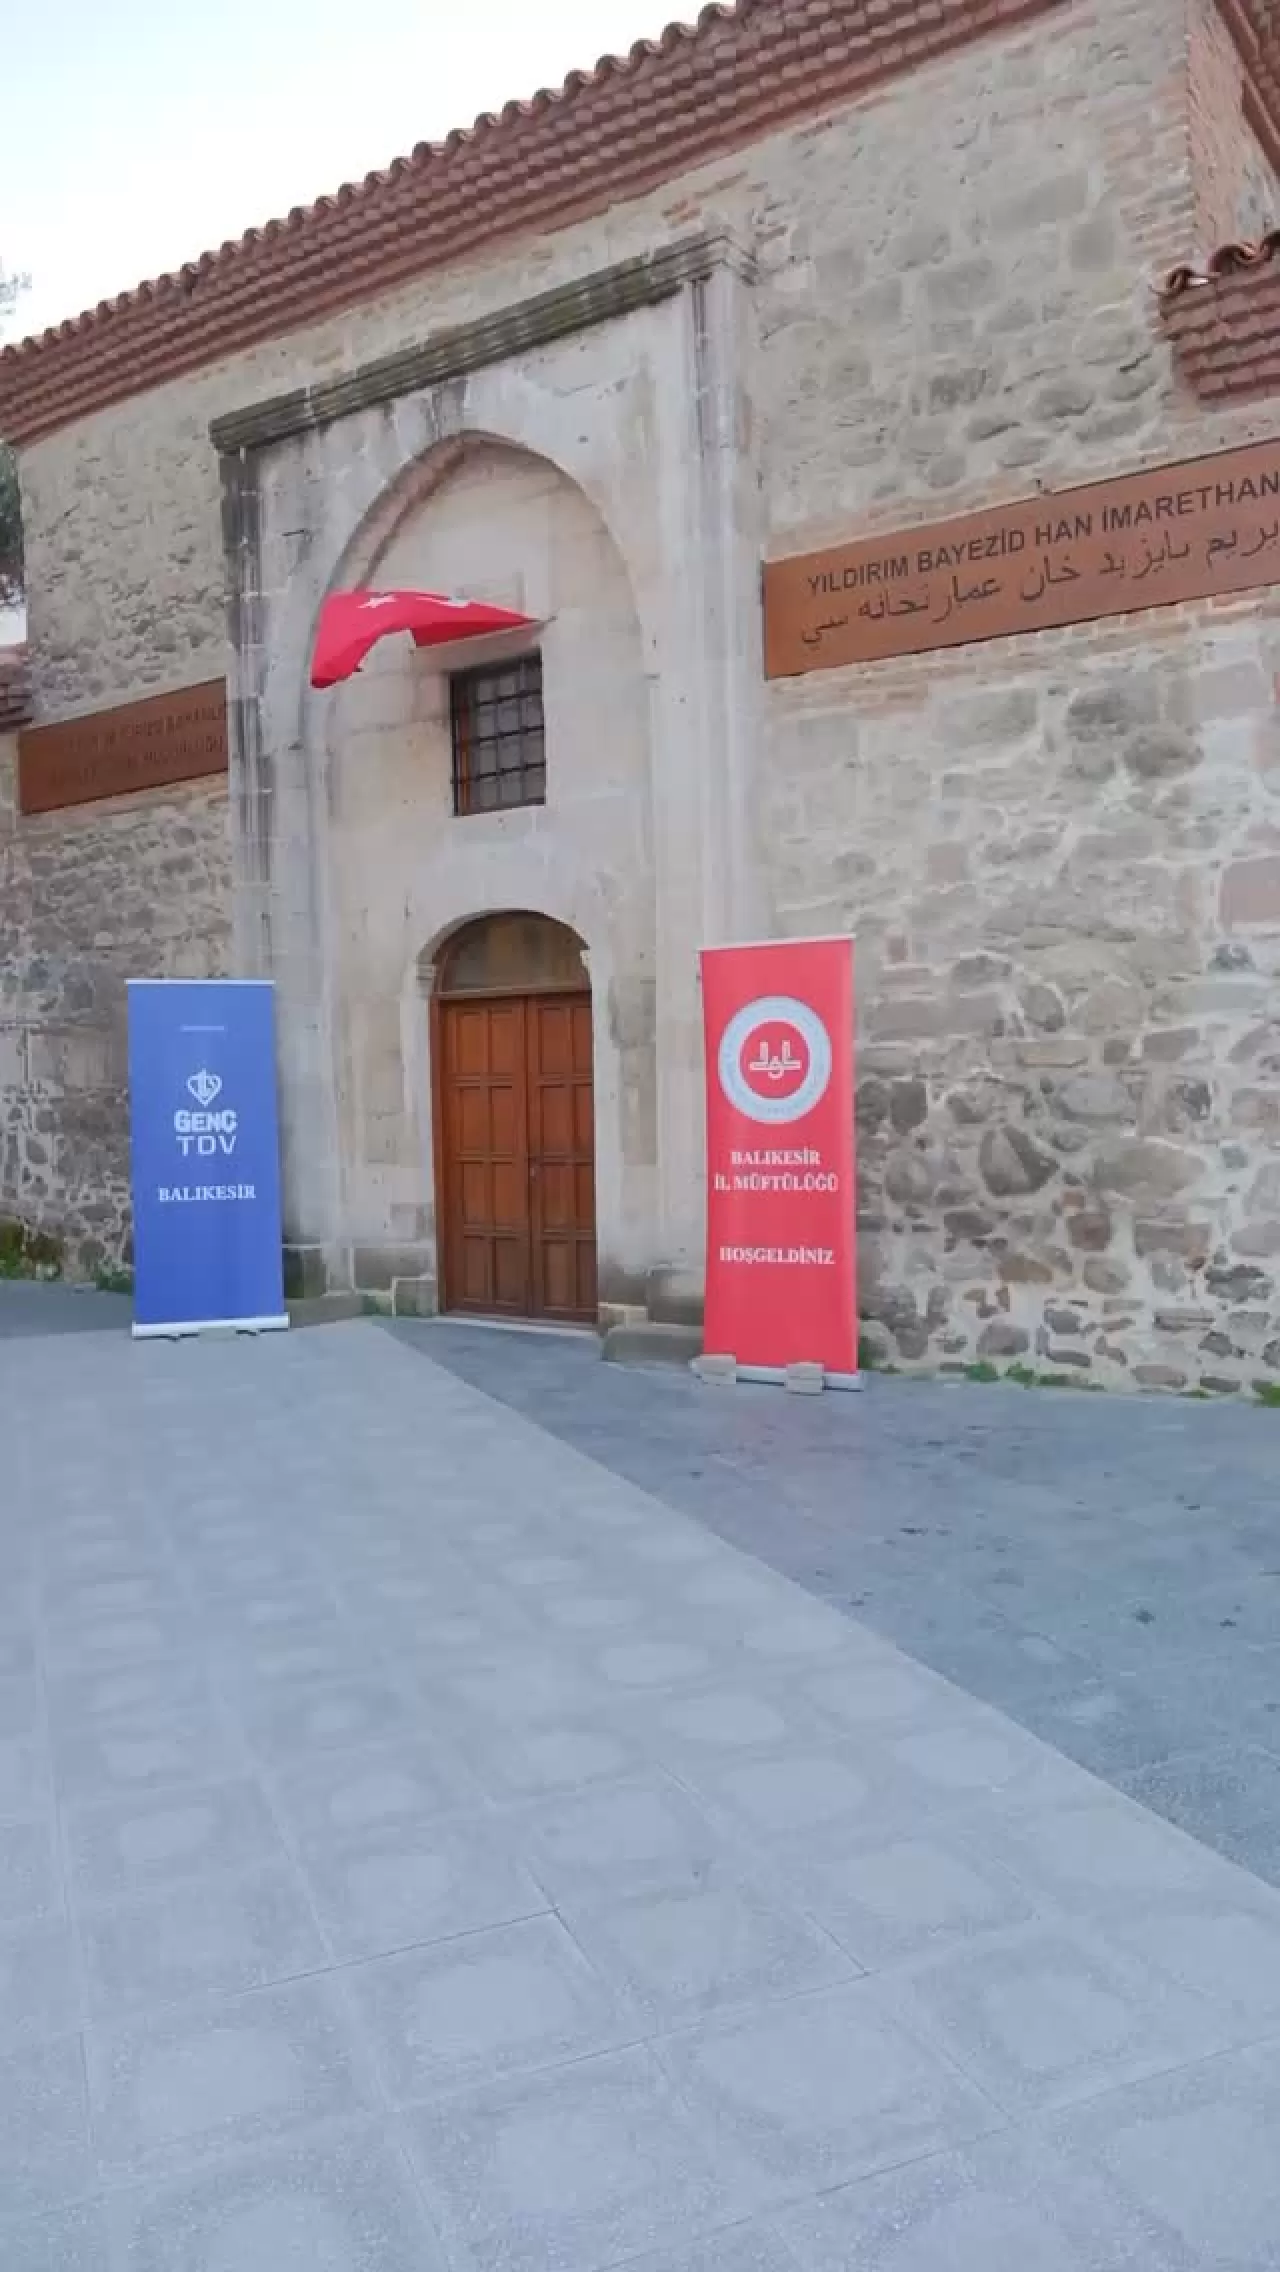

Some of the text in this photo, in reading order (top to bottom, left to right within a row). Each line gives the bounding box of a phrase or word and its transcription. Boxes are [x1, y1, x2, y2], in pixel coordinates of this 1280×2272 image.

[807, 555, 909, 596] YILDIRIM
[917, 527, 1025, 573] BAYEZİD
[1035, 513, 1093, 546] HAN
[175, 1135, 237, 1157] TDV
[730, 1147, 821, 1166] BALIKESİR
[733, 1171, 839, 1192] MÜFTÜLÜĞÜ
[158, 1183, 257, 1202] BALIKESİR
[719, 1245, 837, 1265] HOŞGELDİNİZ
